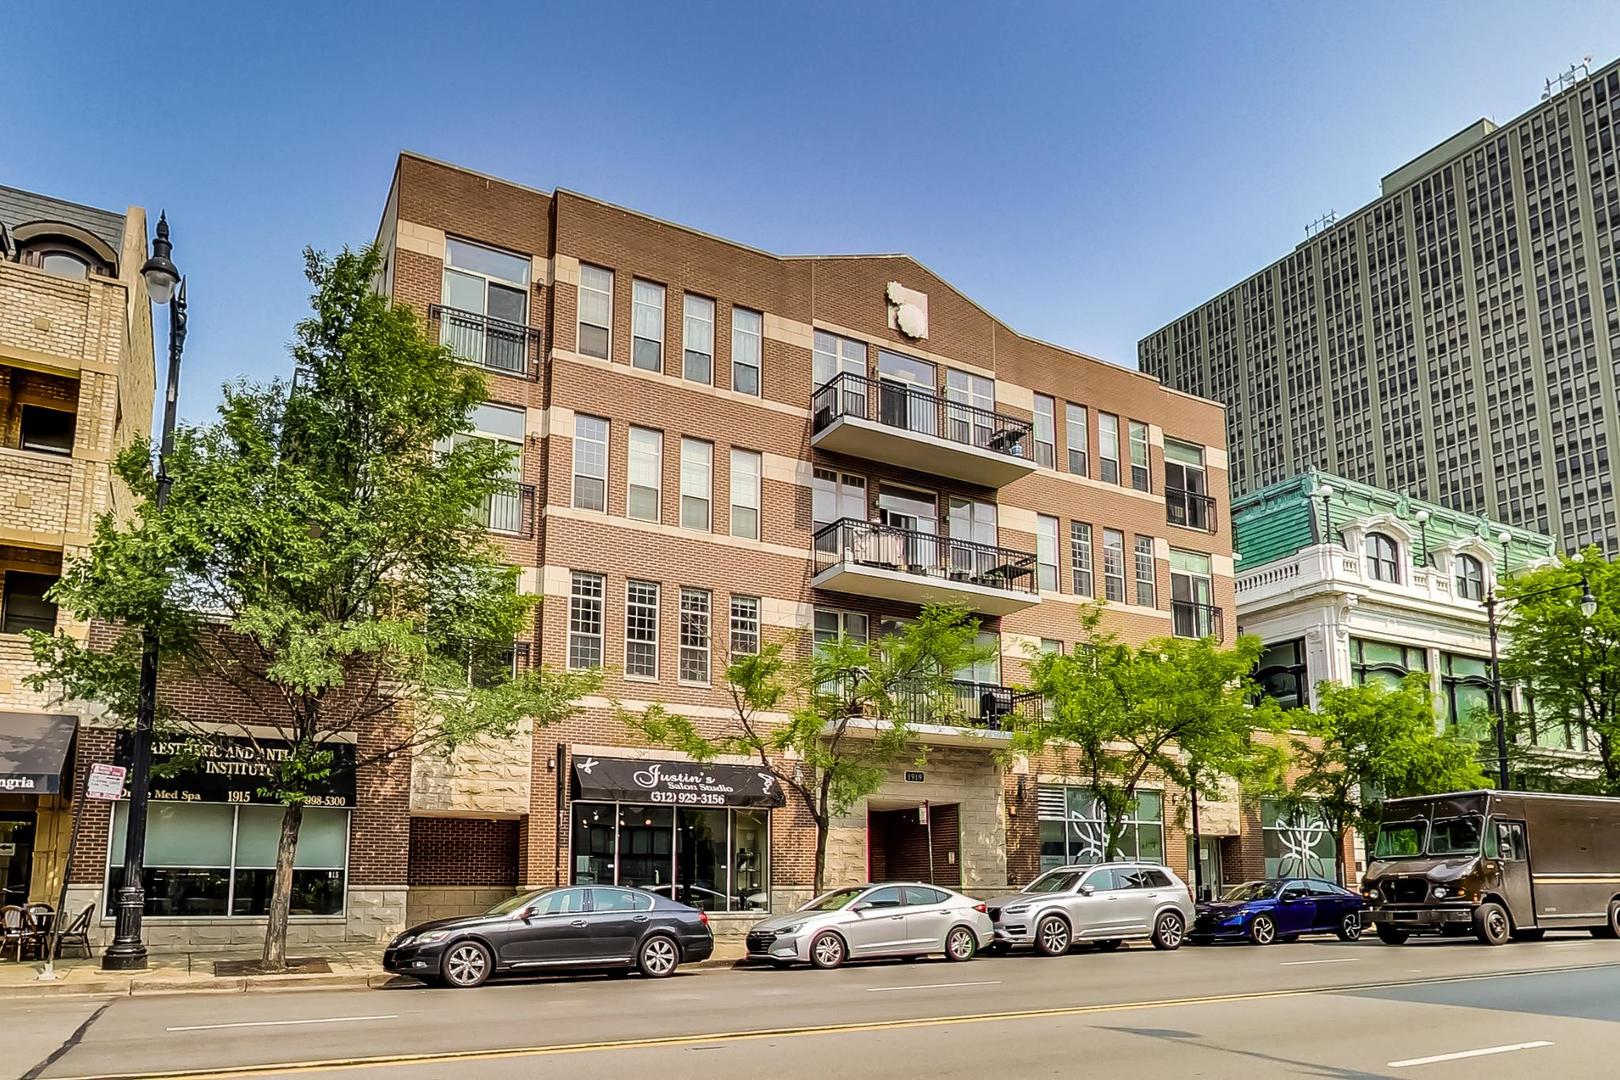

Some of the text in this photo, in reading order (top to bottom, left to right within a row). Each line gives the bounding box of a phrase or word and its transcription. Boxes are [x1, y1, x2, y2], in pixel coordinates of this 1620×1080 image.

[225, 746, 254, 759] AND
[633, 764, 716, 789] Justin's
[907, 772, 923, 781] 1919
[667, 781, 734, 793] Salon Studio
[154, 789, 178, 799] Med
[181, 790, 201, 802] Spa
[227, 790, 251, 802] 1915
[651, 791, 725, 805] (312) 929-3156
